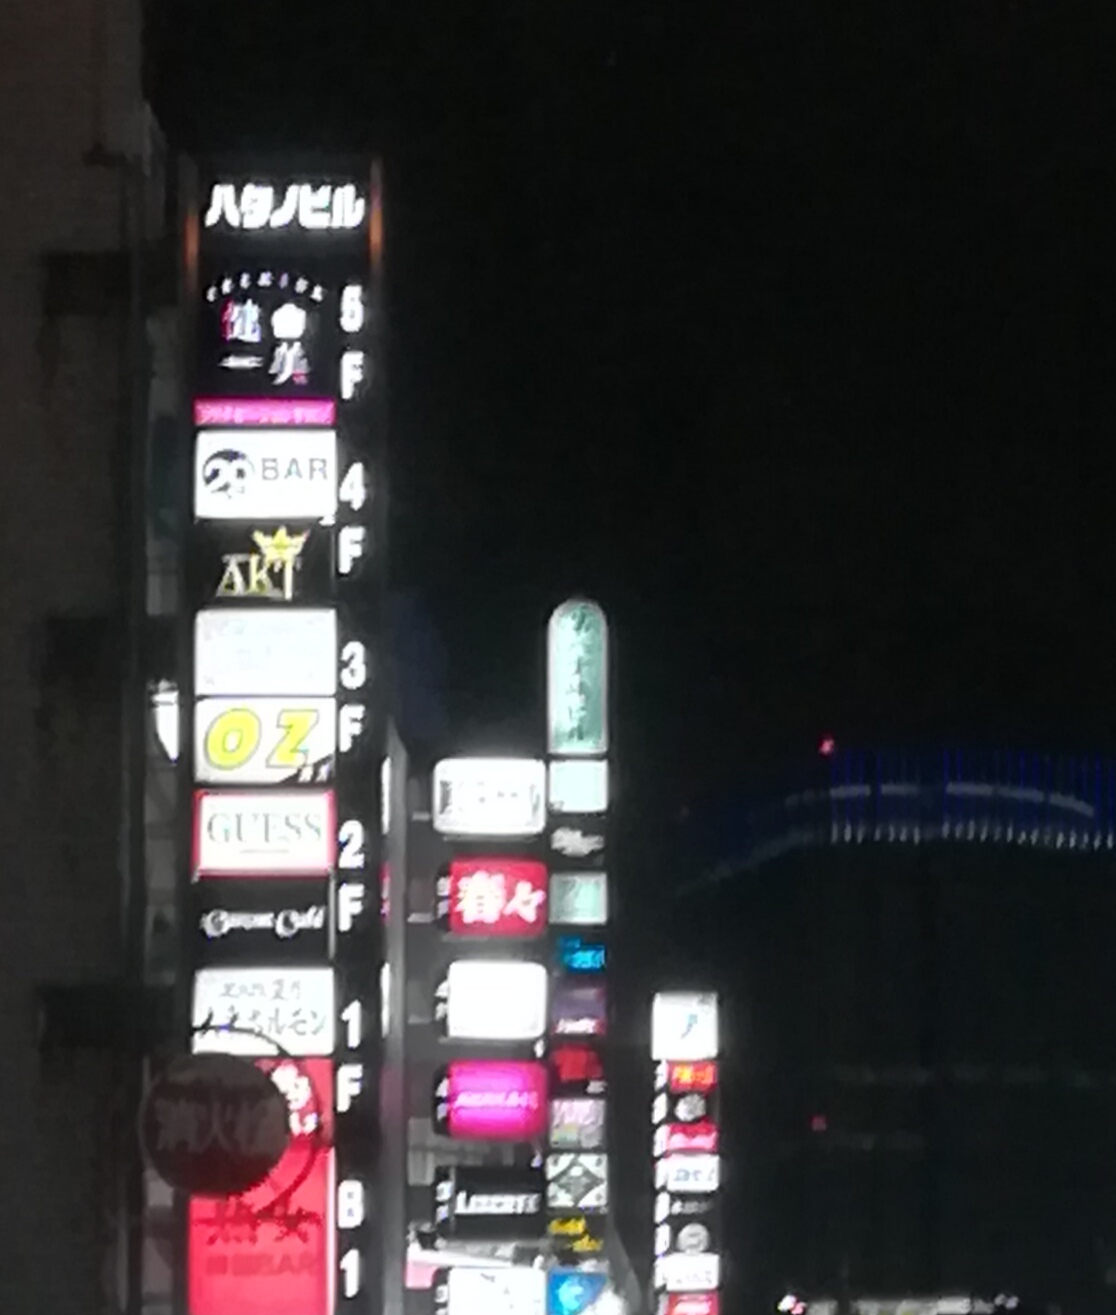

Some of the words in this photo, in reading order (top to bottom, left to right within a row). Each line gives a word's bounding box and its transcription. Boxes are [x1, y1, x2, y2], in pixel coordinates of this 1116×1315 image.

[205, 183, 365, 229] ハタノビル
[261, 457, 328, 481] BAR
[206, 812, 322, 844] GUESS
